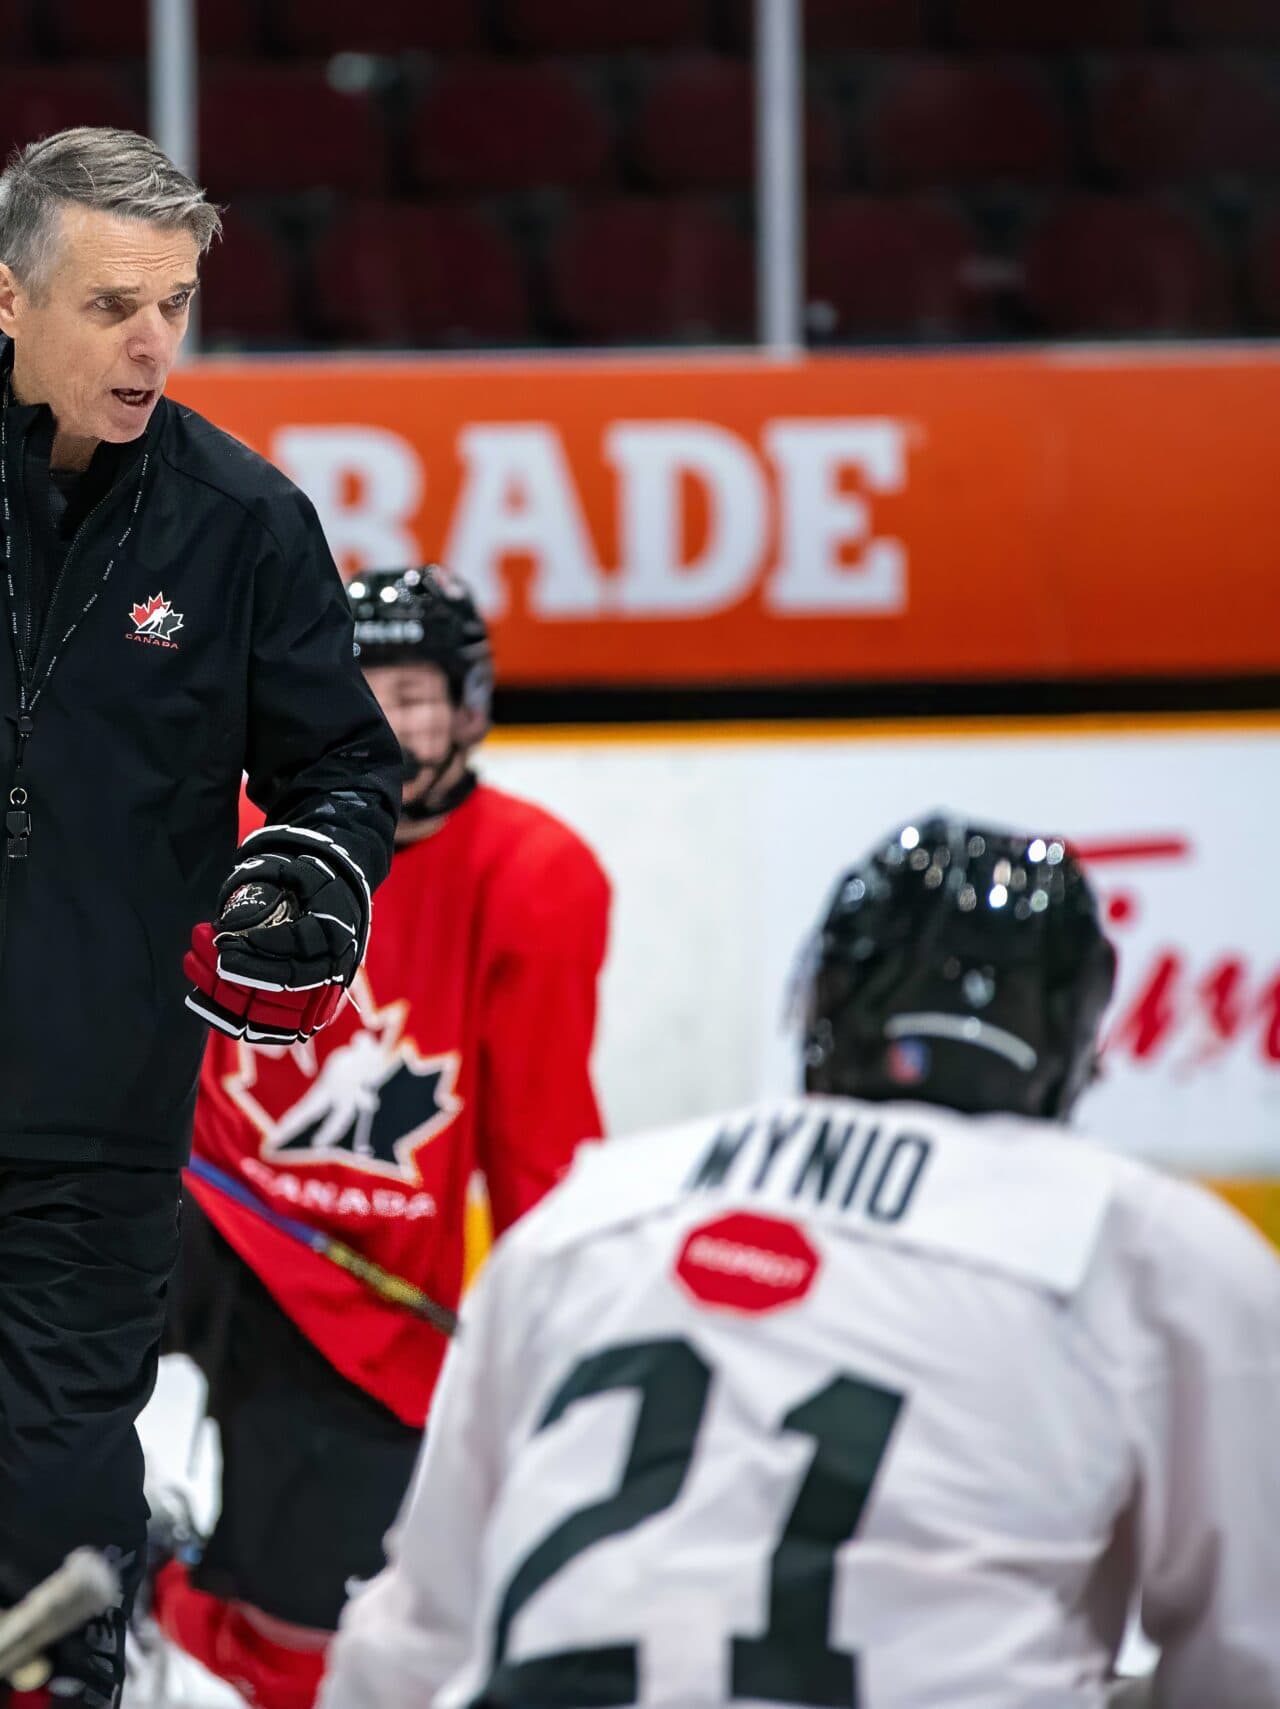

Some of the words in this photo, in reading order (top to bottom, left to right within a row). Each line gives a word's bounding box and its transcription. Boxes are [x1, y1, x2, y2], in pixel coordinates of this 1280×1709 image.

[125, 633, 179, 650] CANADA
[238, 1155, 438, 1221] CANADA
[465, 1333, 910, 1709] 21
